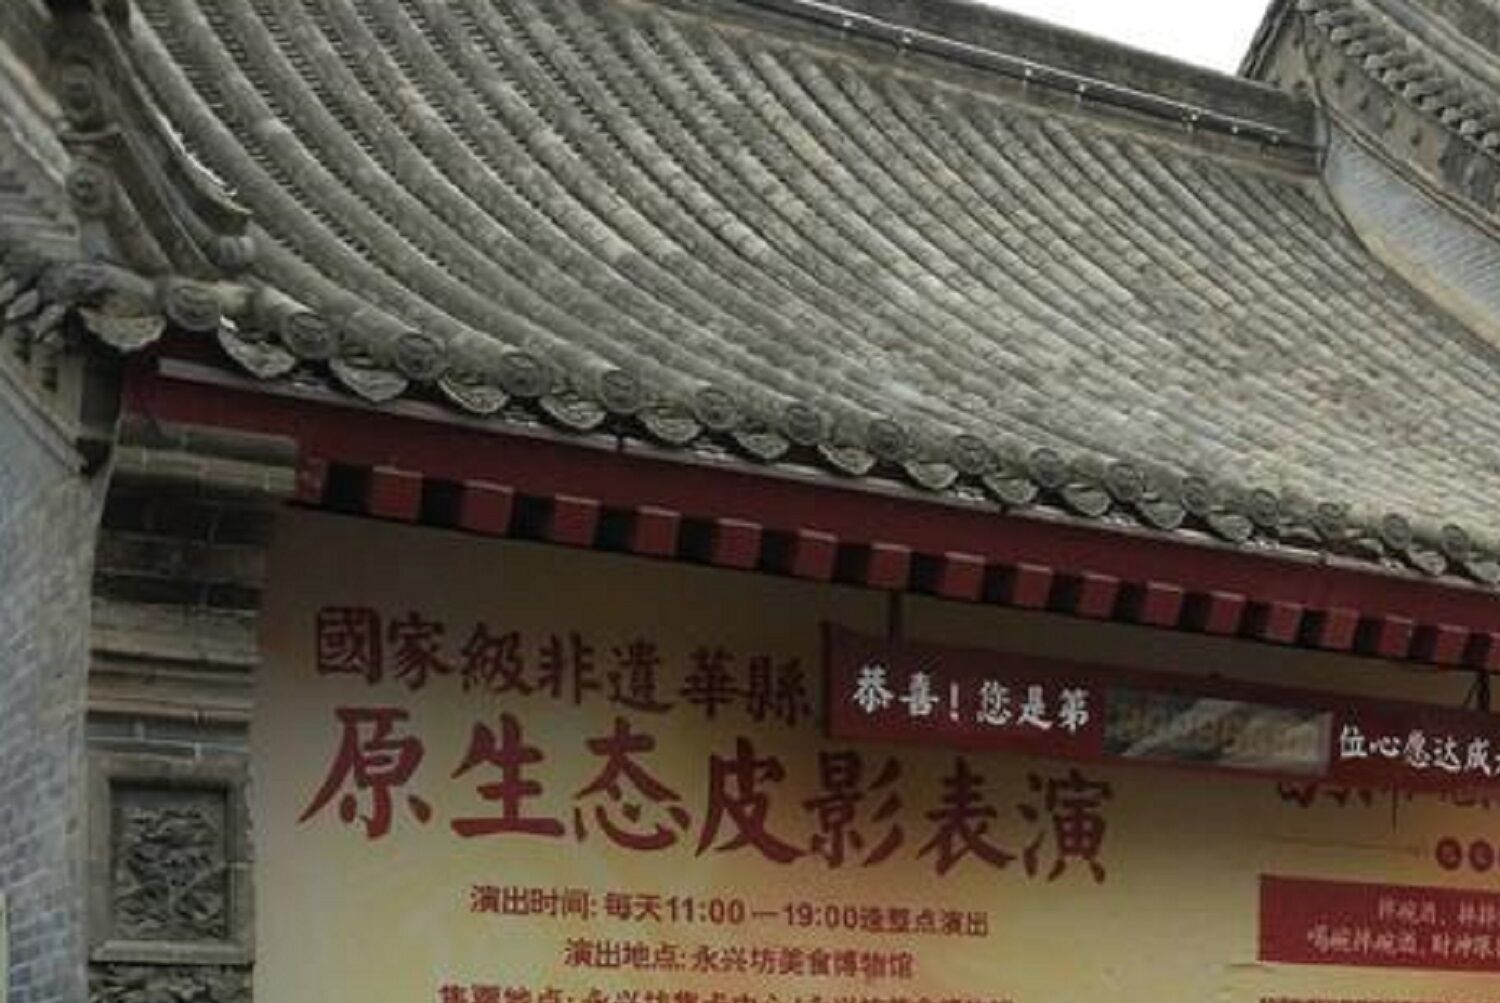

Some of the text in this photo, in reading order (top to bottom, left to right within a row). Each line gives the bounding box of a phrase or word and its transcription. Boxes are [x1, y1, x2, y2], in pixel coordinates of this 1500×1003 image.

[297, 705, 1113, 883] 原生态皮影表演
